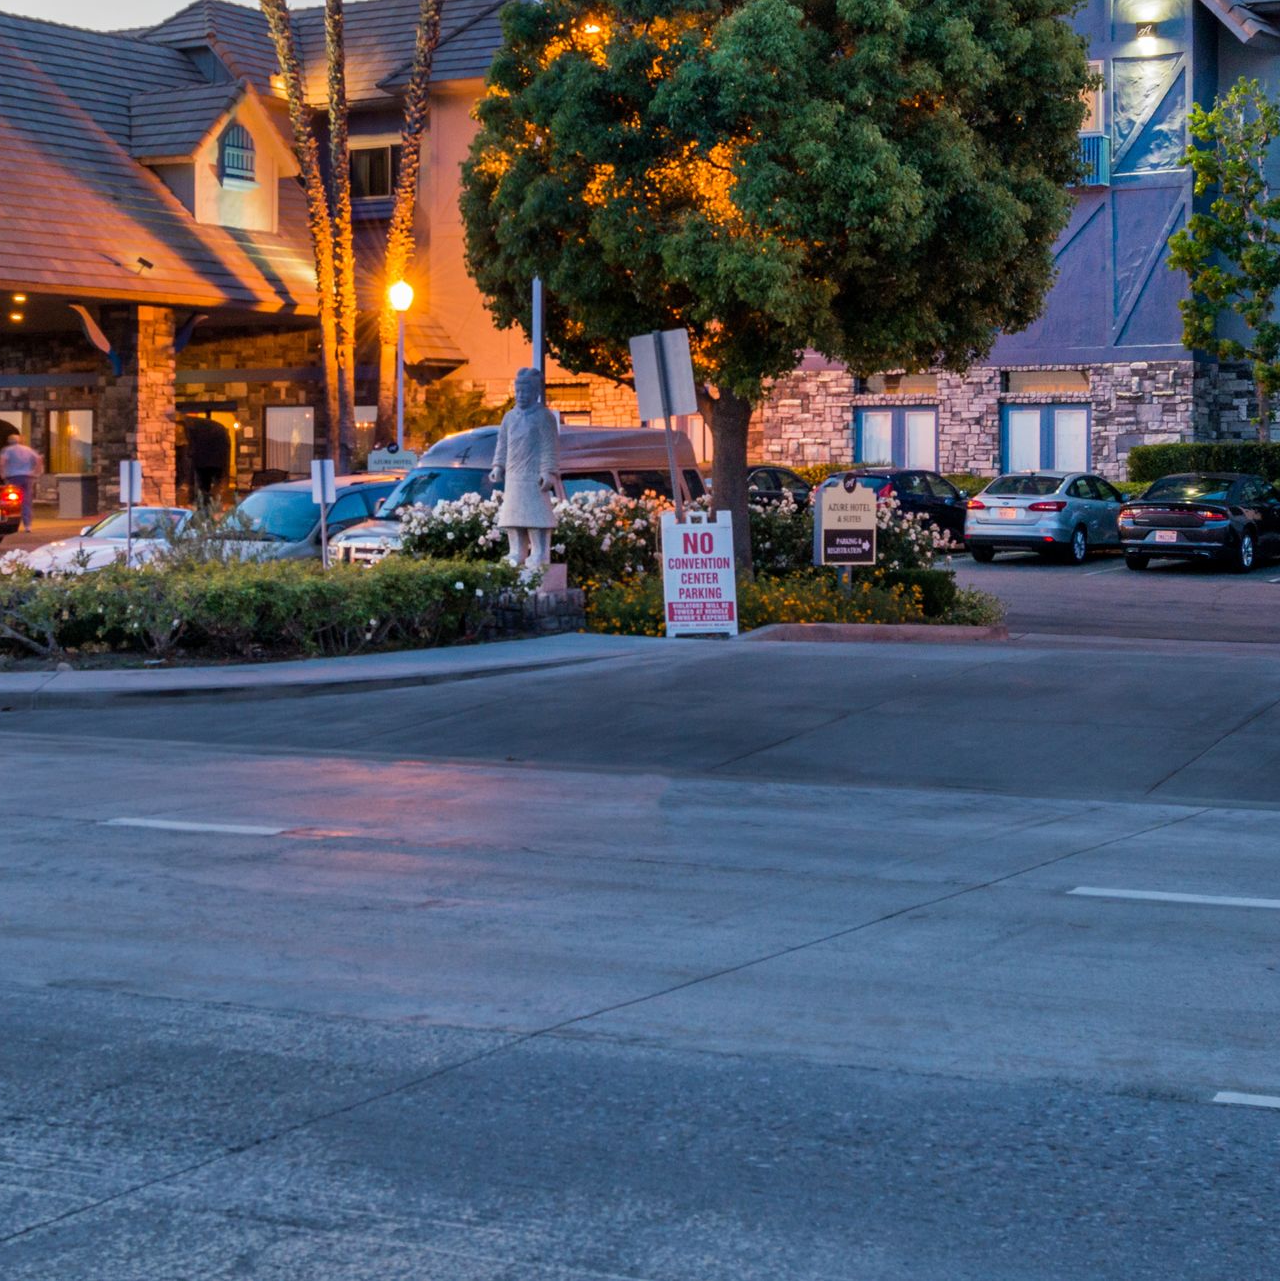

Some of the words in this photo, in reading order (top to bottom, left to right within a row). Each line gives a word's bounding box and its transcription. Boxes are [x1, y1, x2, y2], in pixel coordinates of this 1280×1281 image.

[683, 532, 714, 554] NO
[668, 558, 730, 569] CONVENTION
[681, 572, 719, 584] CENTER
[678, 587, 722, 599] PARKING
